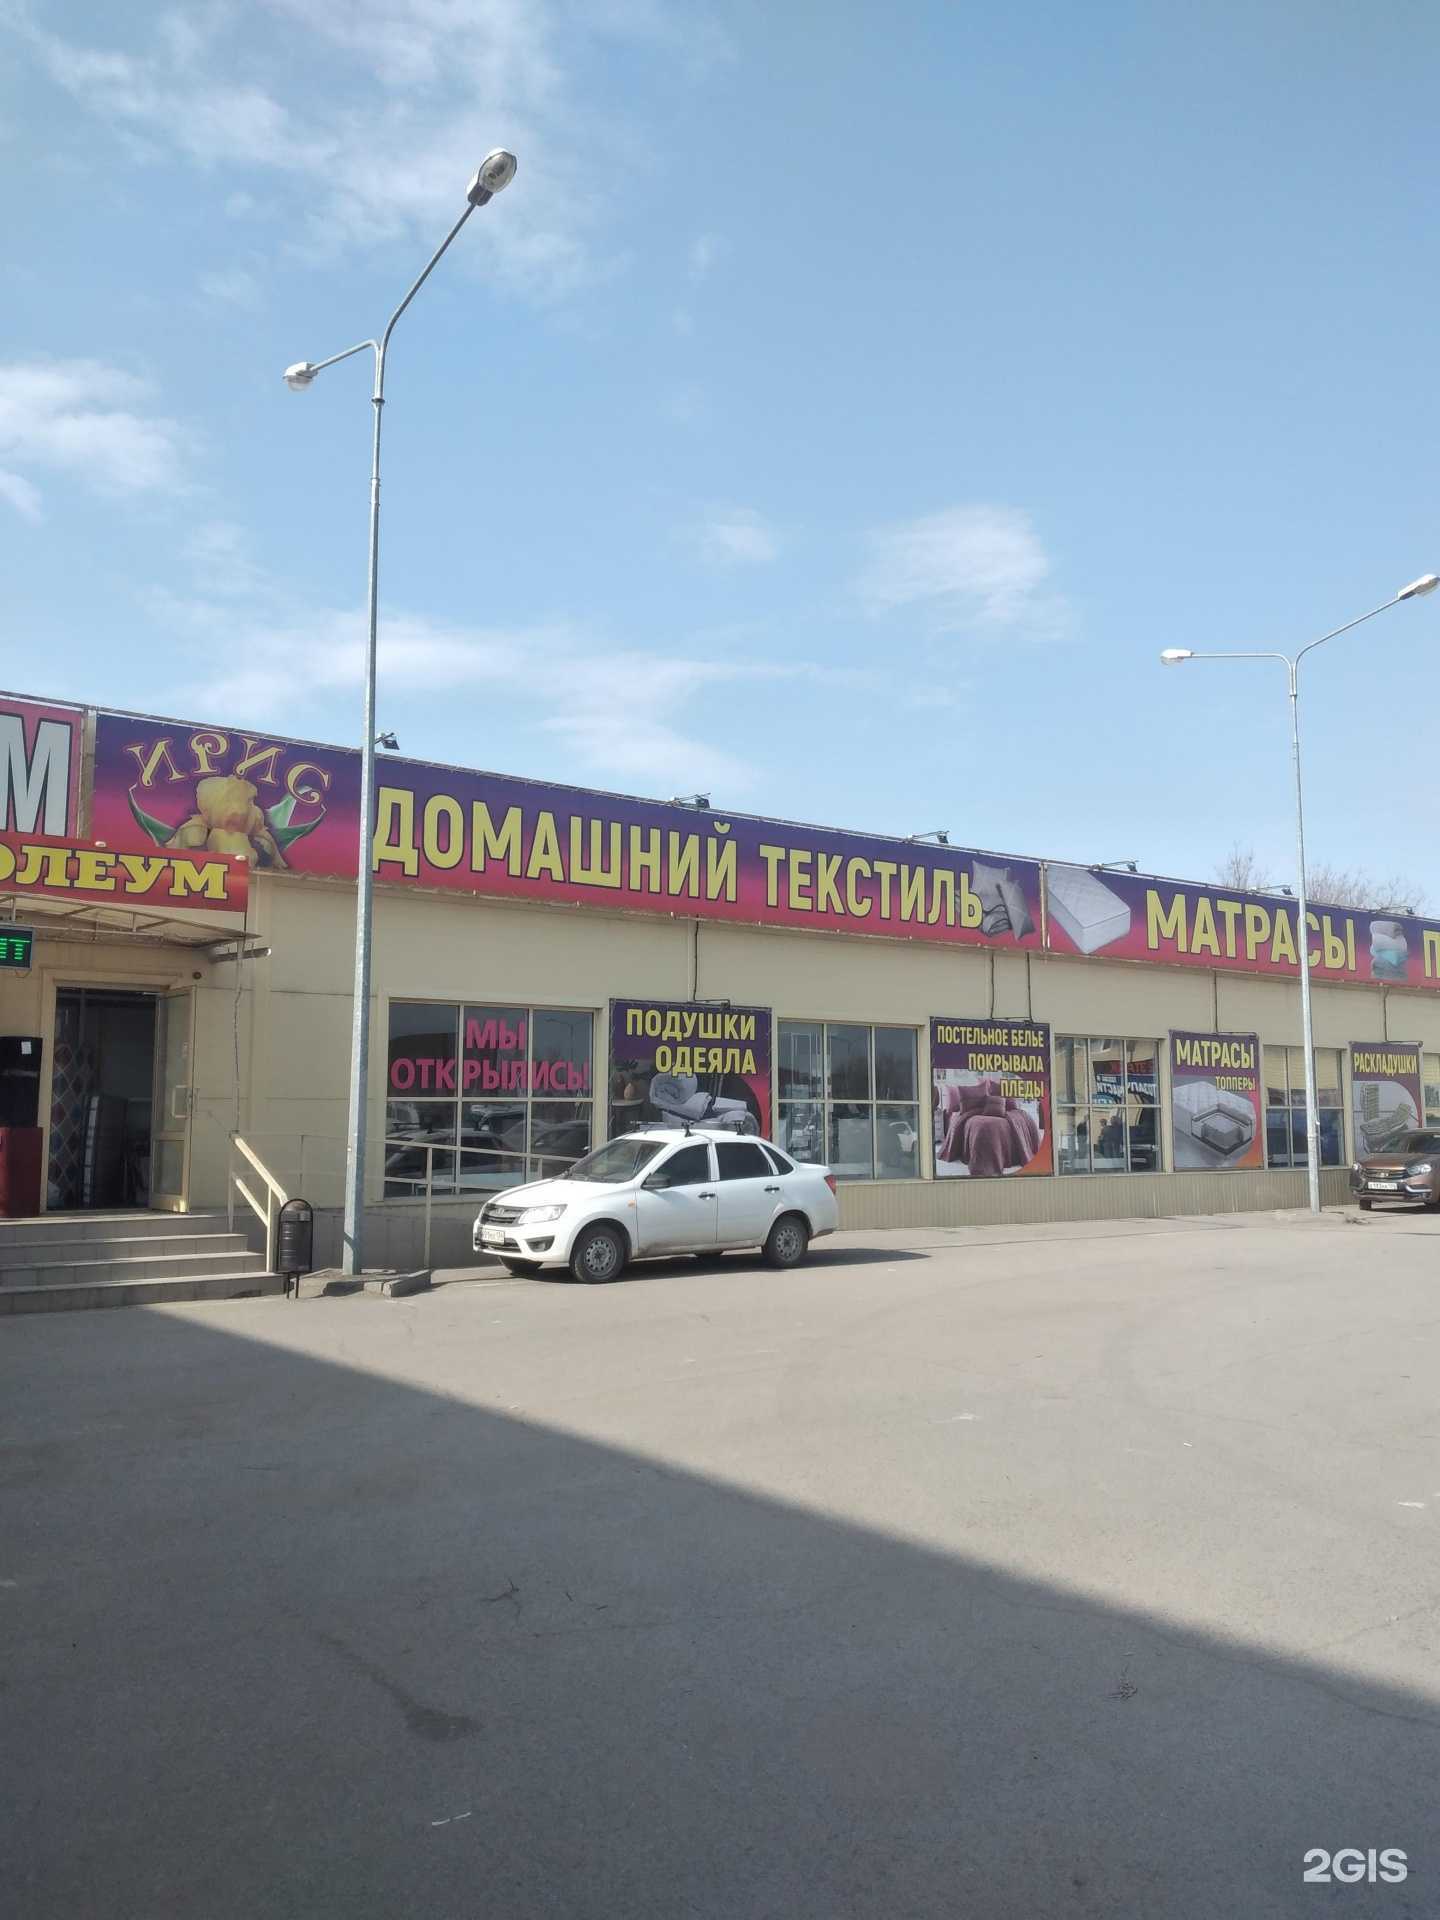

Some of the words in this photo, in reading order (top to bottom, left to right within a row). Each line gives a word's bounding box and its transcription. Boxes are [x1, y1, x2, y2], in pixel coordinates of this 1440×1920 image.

[127, 733, 330, 805] ИРИС
[372, 786, 738, 903] ДОМАШНИЙ
[759, 844, 984, 929] ТЕКСТИЛЬ
[1146, 889, 1357, 971] МАТРАСЫ
[466, 1018, 526, 1049] МЫ
[626, 1008, 756, 1041] ПОДУШКИ
[937, 1025, 1009, 1046] ПОСТЕЛЬНОЕ
[1011, 1029, 1044, 1048] БЕЛЬЕ
[655, 1045, 757, 1077] ОДЕЯЛА
[968, 1053, 1045, 1073] ПОКРЫВАЛА
[1176, 1039, 1255, 1069] МАТРАСЫ
[1353, 1052, 1418, 1077] РАСКЛАДУШКИ
[1000, 1079, 1045, 1100] ПЛЕДЫ
[1215, 1076, 1256, 1091] ТОППЕРЫ
